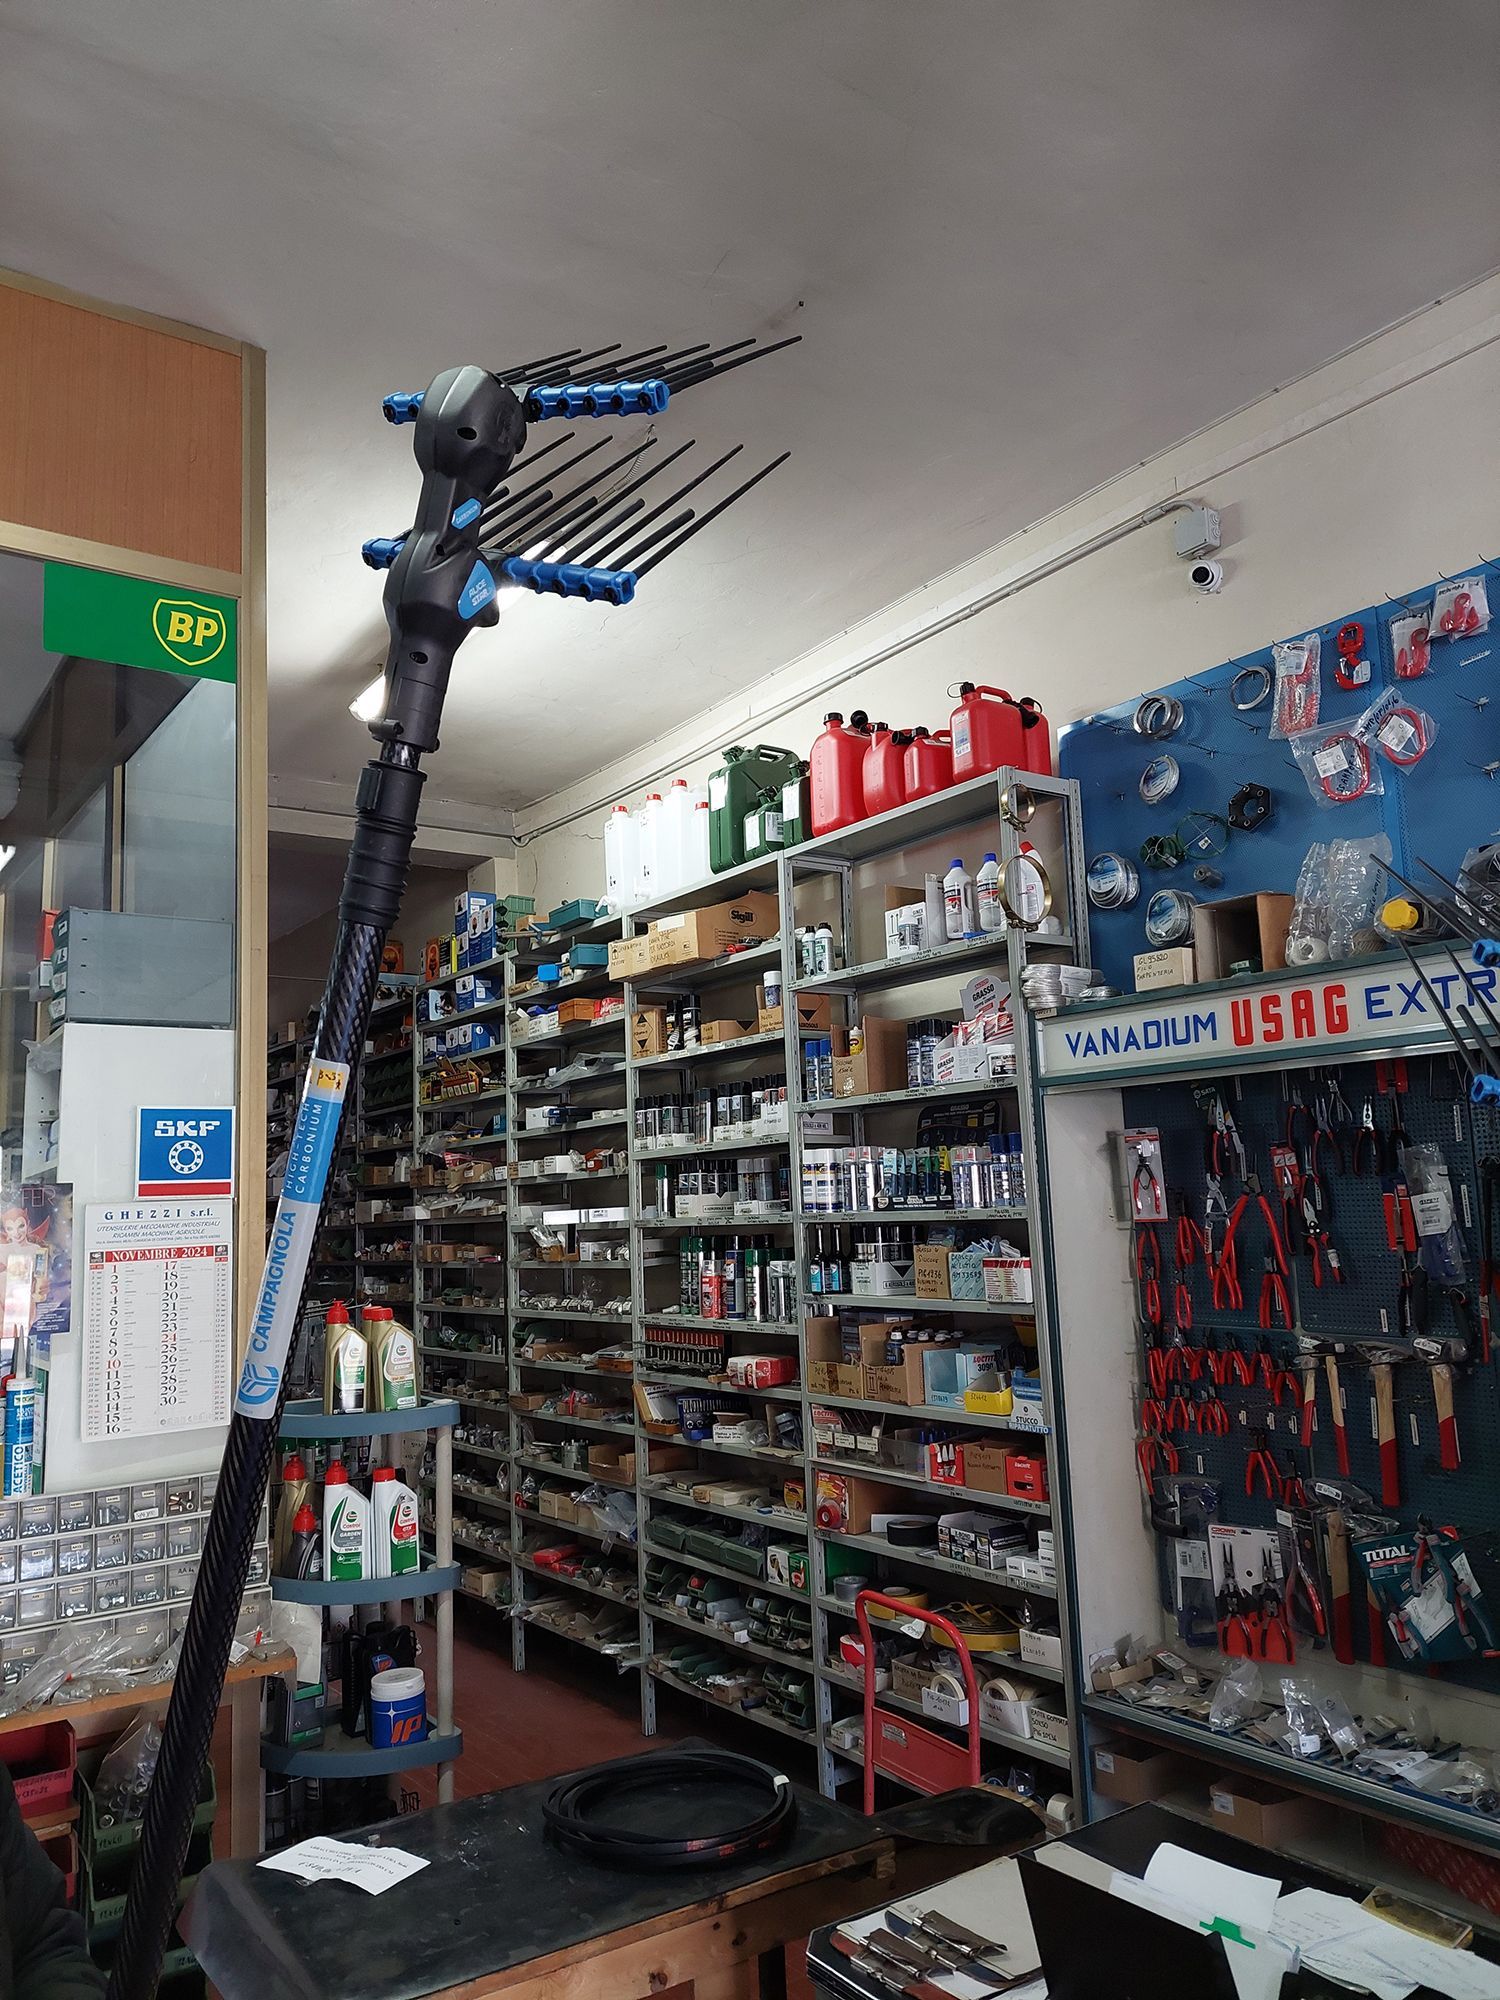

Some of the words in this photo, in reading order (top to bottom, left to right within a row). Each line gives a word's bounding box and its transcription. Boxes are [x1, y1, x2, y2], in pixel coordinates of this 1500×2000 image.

[166, 610, 219, 647] BP
[730, 910, 754, 923] Sigill
[1136, 965, 1153, 973] FILO
[972, 984, 995, 1001] GRASSO
[1065, 1011, 1218, 1058] VANADIUM
[1231, 984, 1349, 1047] USAG
[937, 1056, 955, 1070] GRASSO
[1201, 1087, 1216, 1096] SATA
[154, 1120, 221, 1137] SKF
[286, 1102, 310, 1189] HIGH-TECH
[295, 1104, 322, 1194] CARBONIUM
[104, 1209, 181, 1221] GHEZZI
[190, 1207, 214, 1218] s.r.l.
[96, 1224, 138, 1233] UTENSILERIE
[140, 1221, 180, 1230] MECCANICHE
[180, 1220, 221, 1228] INDUSTRIALI
[112, 1231, 140, 1239] RICAMBI
[175, 1228, 205, 1236] AGRICOLE
[112, 1247, 178, 1262] NOVEMBRE
[182, 1246, 208, 1258] 2024
[112, 1264, 117, 1273] 1
[164, 1261, 178, 1271] 17
[110, 1275, 119, 1285] 2
[164, 1271, 178, 1281] 18
[164, 1281, 178, 1291] 19
[251, 1210, 297, 1353] CAMPAGNOLA
[110, 1285, 118, 1295] 3
[109, 1296, 118, 1305] 4
[162, 1291, 178, 1301] 20
[109, 1306, 118, 1316] 5
[161, 1302, 177, 1312] 21
[109, 1317, 118, 1327] 6
[161, 1312, 177, 1322] 22
[161, 1322, 177, 1332] 23
[110, 1328, 118, 1337] 7
[108, 1338, 118, 1348] 8
[161, 1333, 177, 1343] 24
[161, 1343, 177, 1353] 25
[108, 1349, 118, 1358] 9
[106, 1359, 121, 1369] 10
[161, 1354, 177, 1364] 26
[973, 1355, 997, 1363] LOCTIT
[161, 1365, 177, 1374] 27
[106, 1370, 119, 1380] 11
[160, 1375, 177, 1385] 28
[106, 1381, 121, 1391] 12
[160, 1385, 177, 1395] 29
[105, 1391, 120, 1401] 13
[160, 1396, 177, 1406] 30
[105, 1402, 120, 1412] 14
[105, 1412, 120, 1423] 15
[1015, 1416, 1039, 1425] STUCCO
[105, 1424, 120, 1434] 16
[1009, 1421, 1049, 1434] RIPARATUTTO
[13, 1446, 24, 1493] ACETICO
[1362, 1545, 1410, 1562] TOTAL
[390, 1713, 422, 1744] IP
